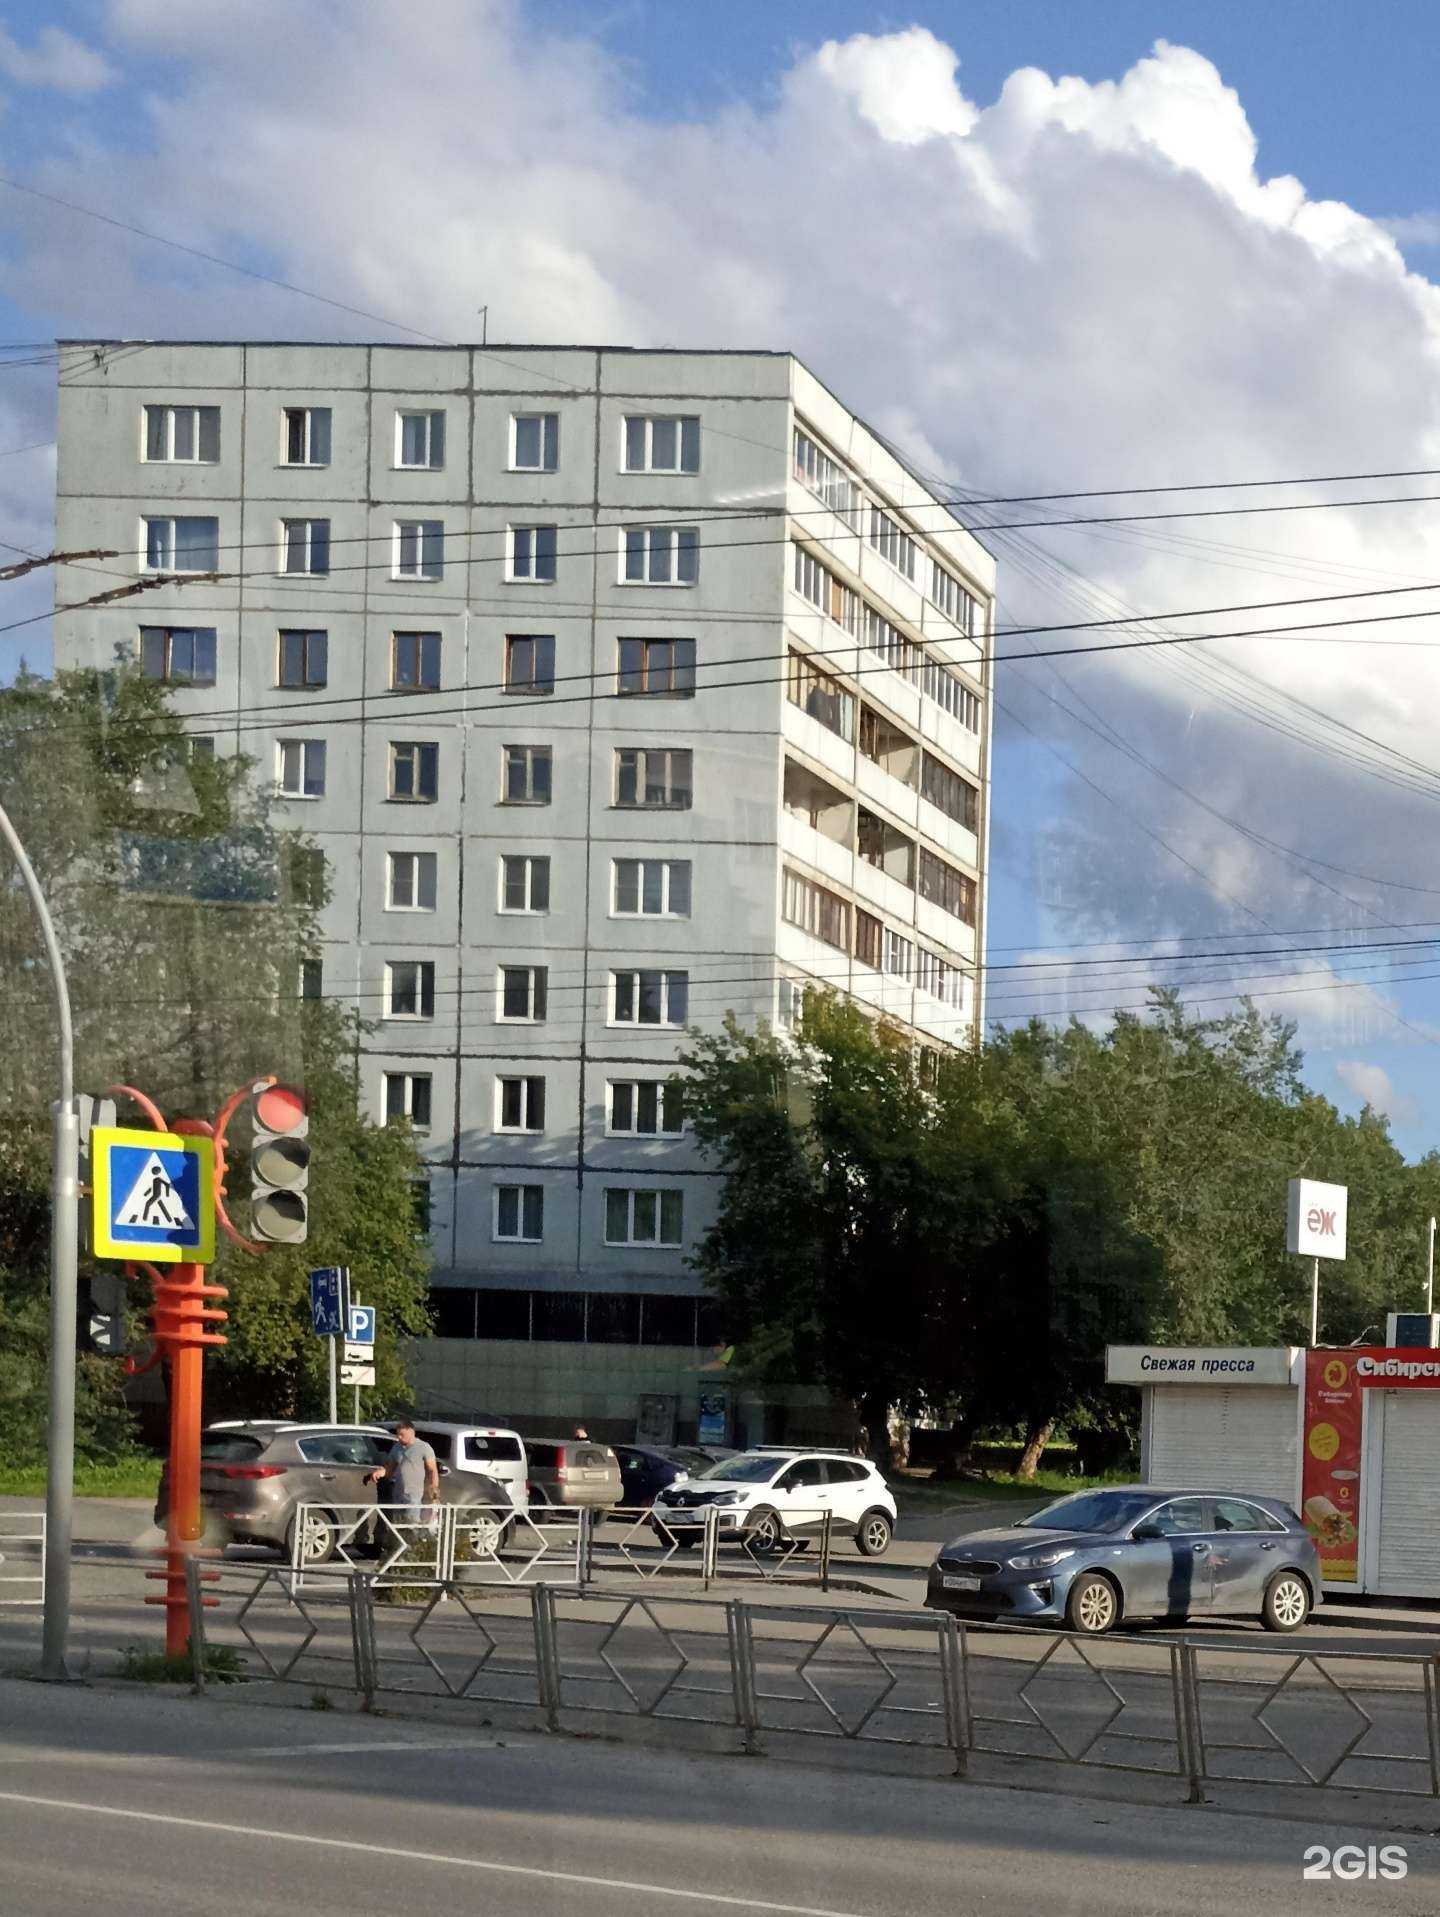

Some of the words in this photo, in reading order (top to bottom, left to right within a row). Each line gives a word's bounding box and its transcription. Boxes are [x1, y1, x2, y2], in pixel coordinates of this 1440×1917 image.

[351, 1310, 369, 1340] P
[1140, 1355, 1196, 1371] Свежая
[1201, 1359, 1255, 1374] пресса
